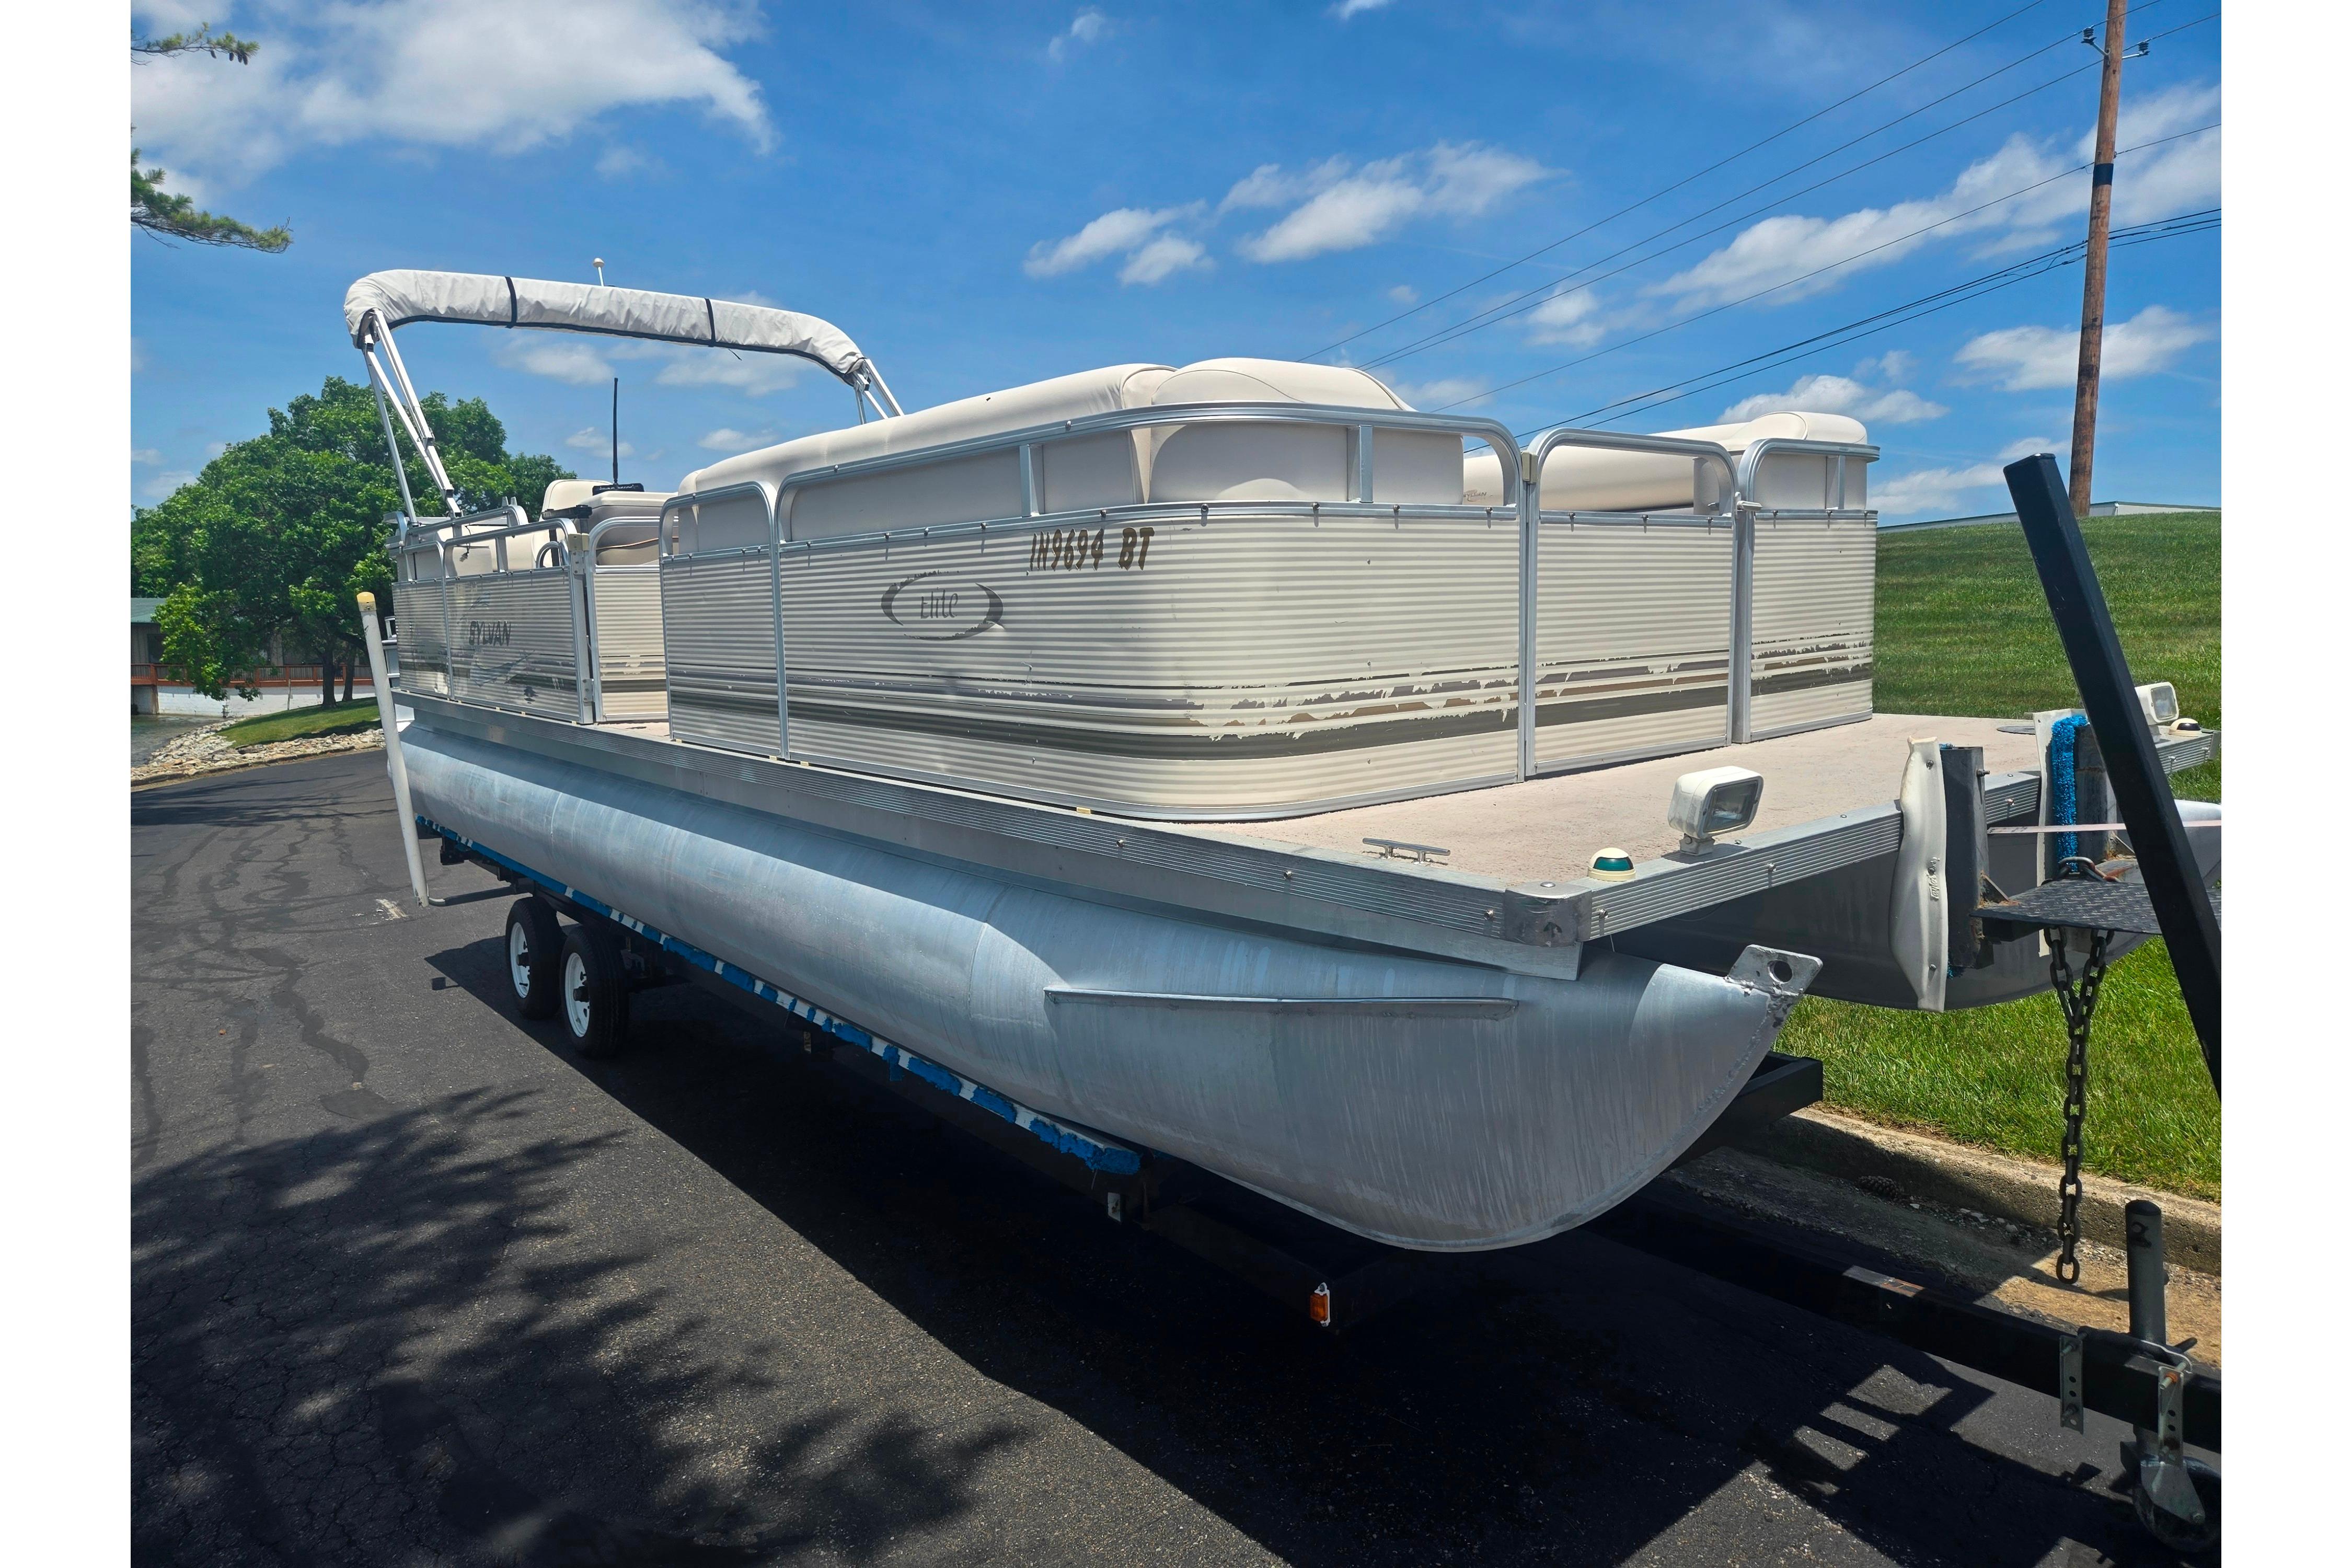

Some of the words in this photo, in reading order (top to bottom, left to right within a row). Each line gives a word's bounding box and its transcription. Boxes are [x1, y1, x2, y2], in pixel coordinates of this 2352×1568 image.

[1118, 527, 1155, 571] BT
[920, 587, 959, 619] Elite
[469, 620, 511, 646] SYLVAN
